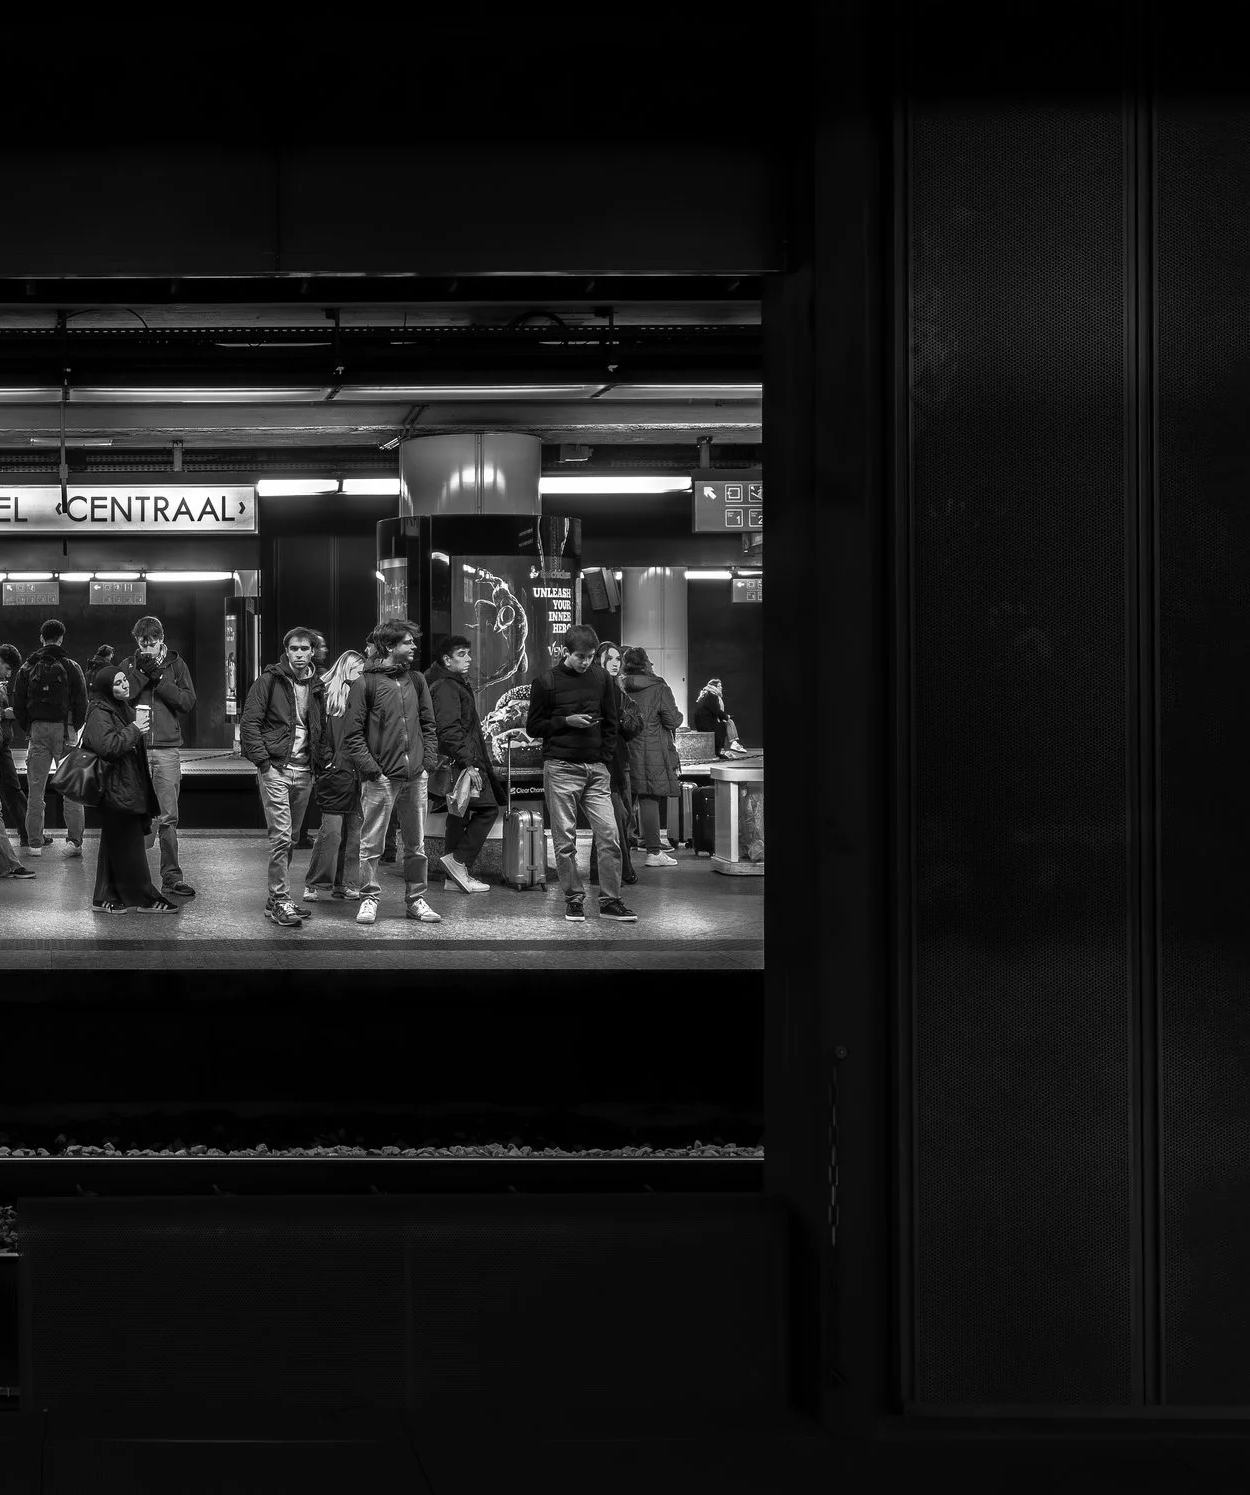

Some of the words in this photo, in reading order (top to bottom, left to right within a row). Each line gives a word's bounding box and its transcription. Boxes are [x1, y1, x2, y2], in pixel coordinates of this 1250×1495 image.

[532, 587, 571, 598] UNLEASH
[552, 599, 571, 610] YOUR
[548, 611, 571, 622] INNER
